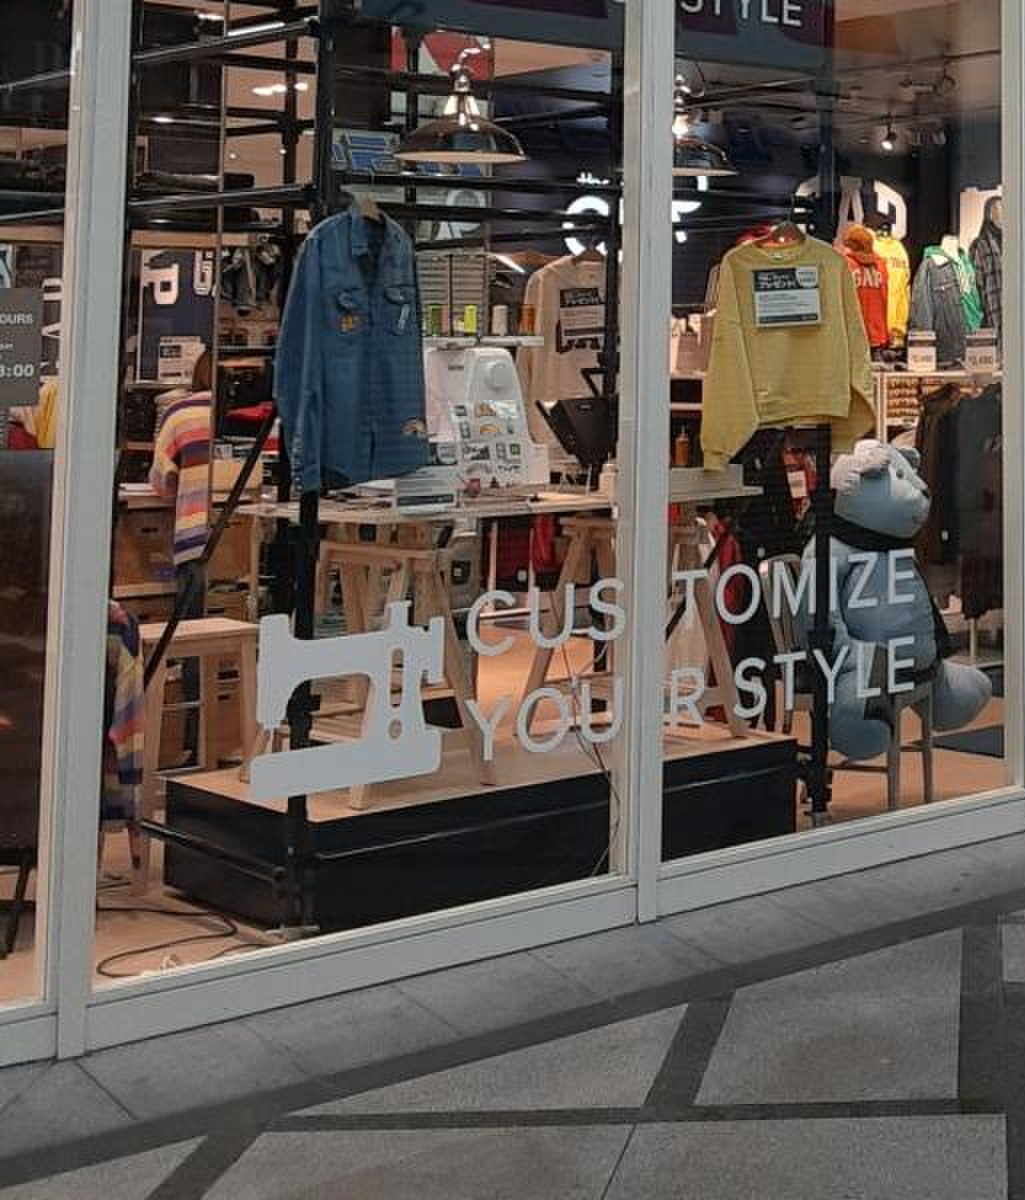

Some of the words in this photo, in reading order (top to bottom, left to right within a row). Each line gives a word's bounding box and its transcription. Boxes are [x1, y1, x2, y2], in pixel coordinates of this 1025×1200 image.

[465, 549, 916, 657] CUSTOMIZE
[466, 665, 706, 763] YOUR
[733, 636, 916, 720] STYLE
